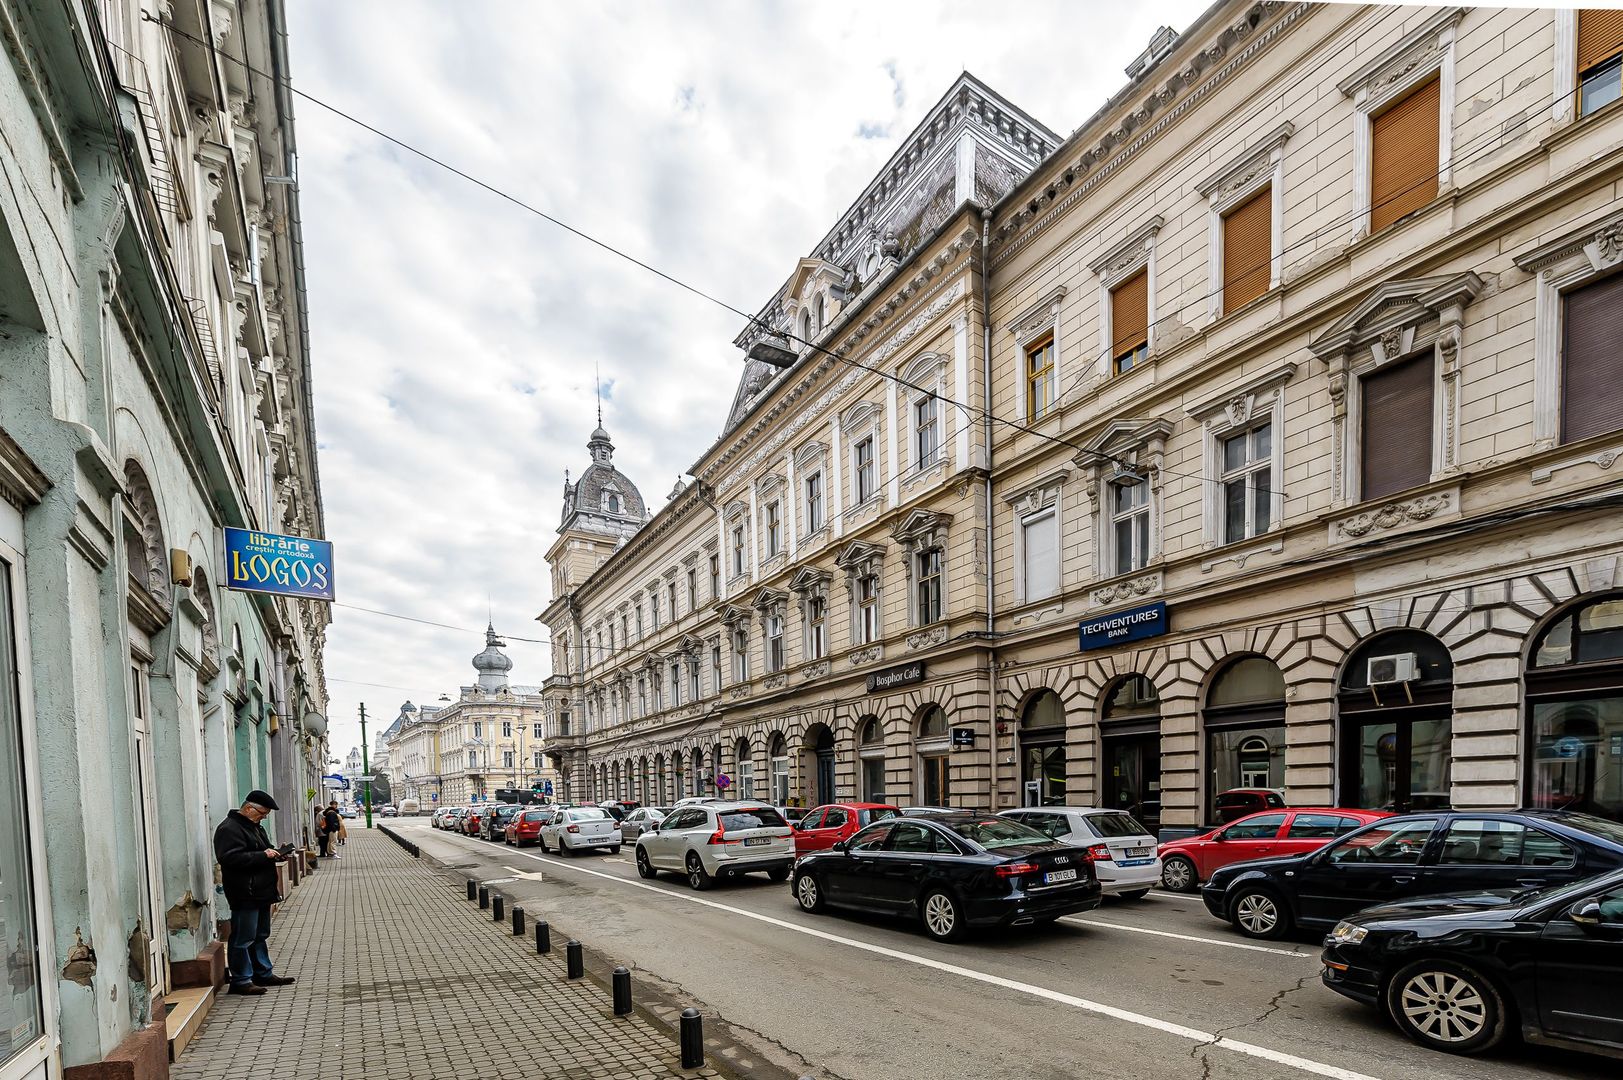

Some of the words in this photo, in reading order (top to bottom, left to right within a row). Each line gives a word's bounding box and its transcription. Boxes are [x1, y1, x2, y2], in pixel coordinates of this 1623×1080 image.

[249, 532, 310, 552] librărie
[232, 550, 329, 590] LOGOS
[1081, 609, 1158, 635] TECHVENTURES
[1108, 628, 1128, 638] BANK
[876, 672, 903, 686] Bosphor
[903, 667, 920, 680] Cafe
